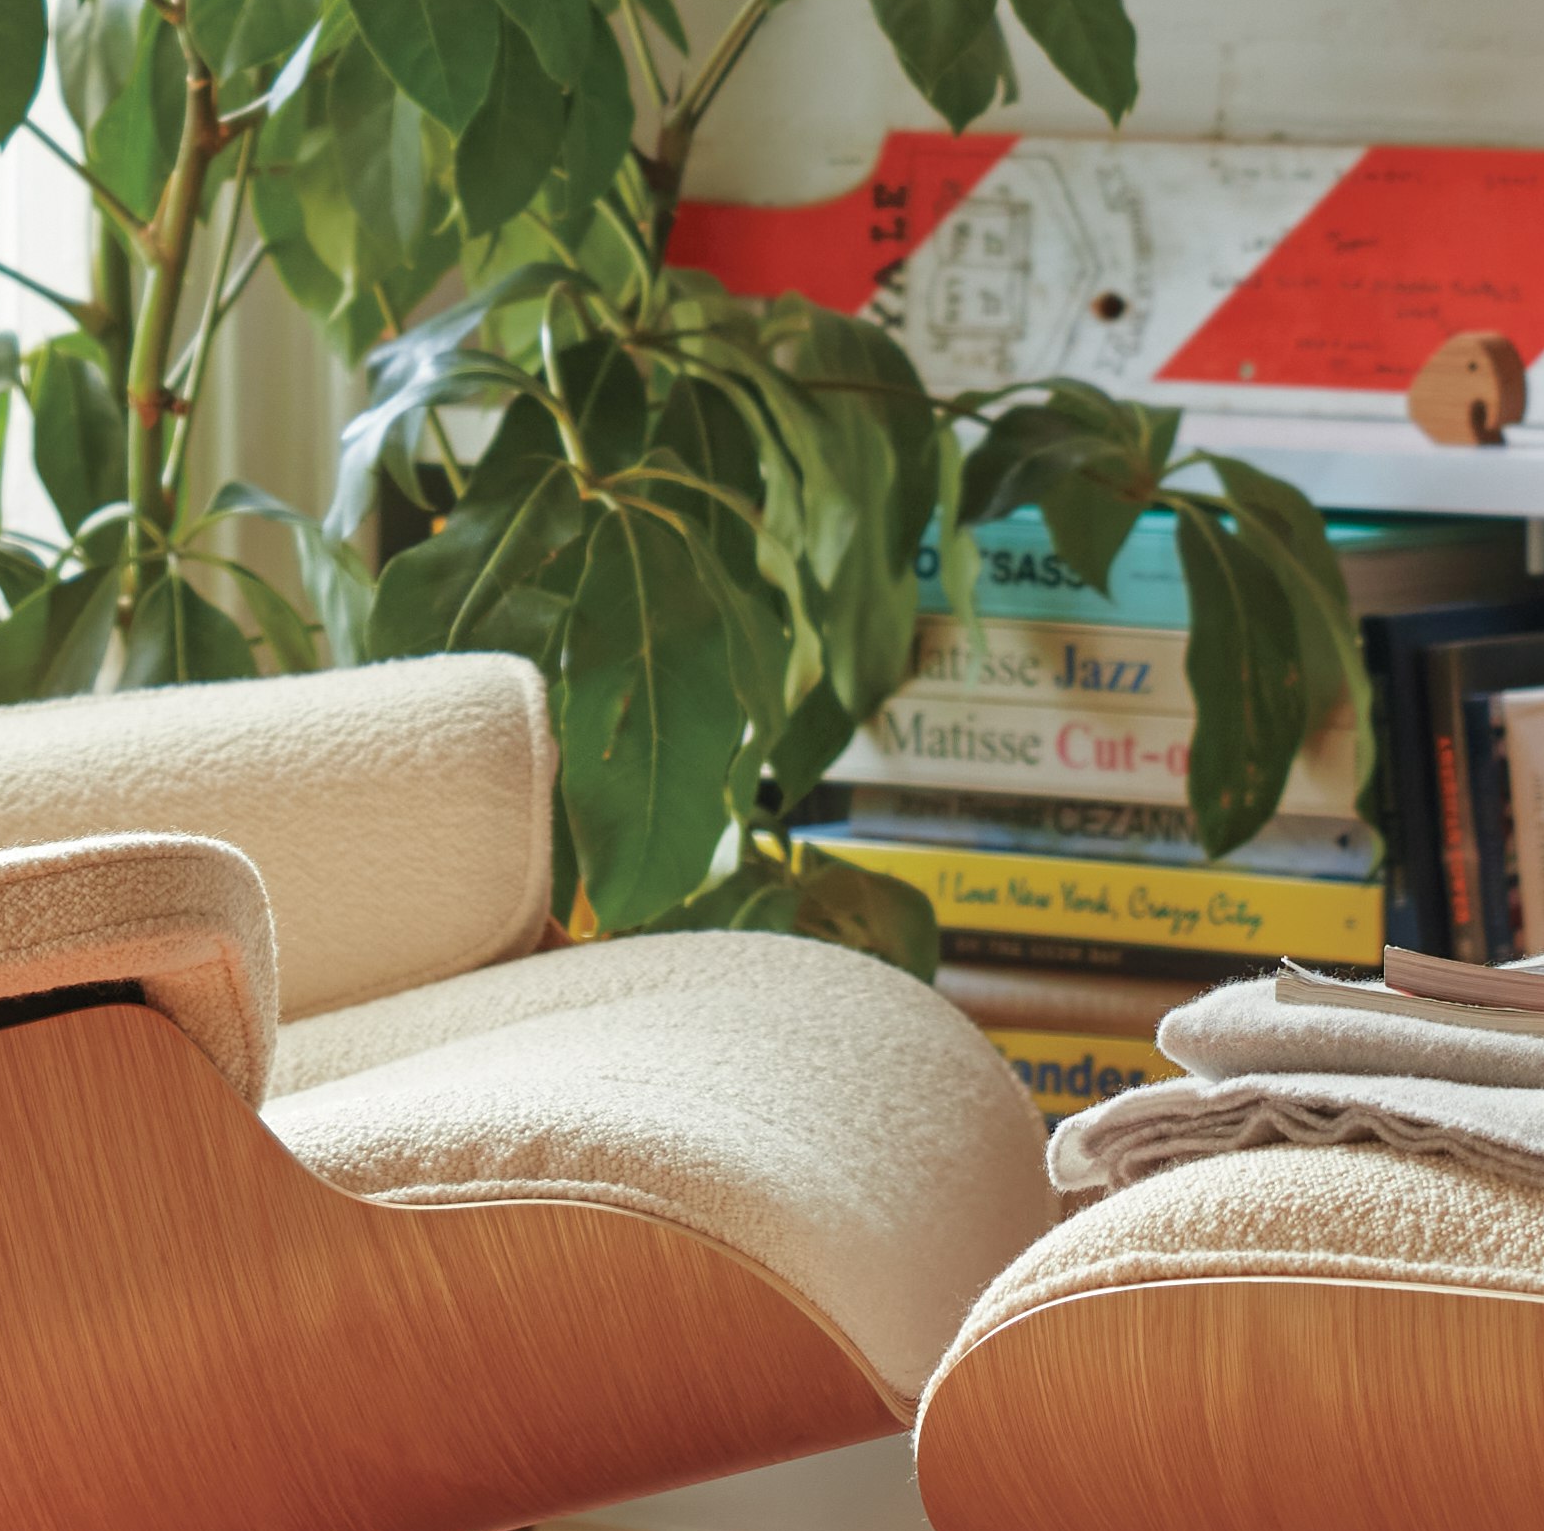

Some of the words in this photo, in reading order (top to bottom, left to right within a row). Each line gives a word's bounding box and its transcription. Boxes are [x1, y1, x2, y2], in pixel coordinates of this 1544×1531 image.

[1055, 645, 1154, 695] Jazz
[879, 710, 1040, 766] Matisse
[1055, 722, 1190, 777] Cut-o
[1057, 802, 1195, 843] CEZANN
[955, 871, 998, 907] Love
[1008, 874, 1050, 911] New
[1129, 884, 1201, 935] Crazy
[1208, 891, 1265, 938] City
